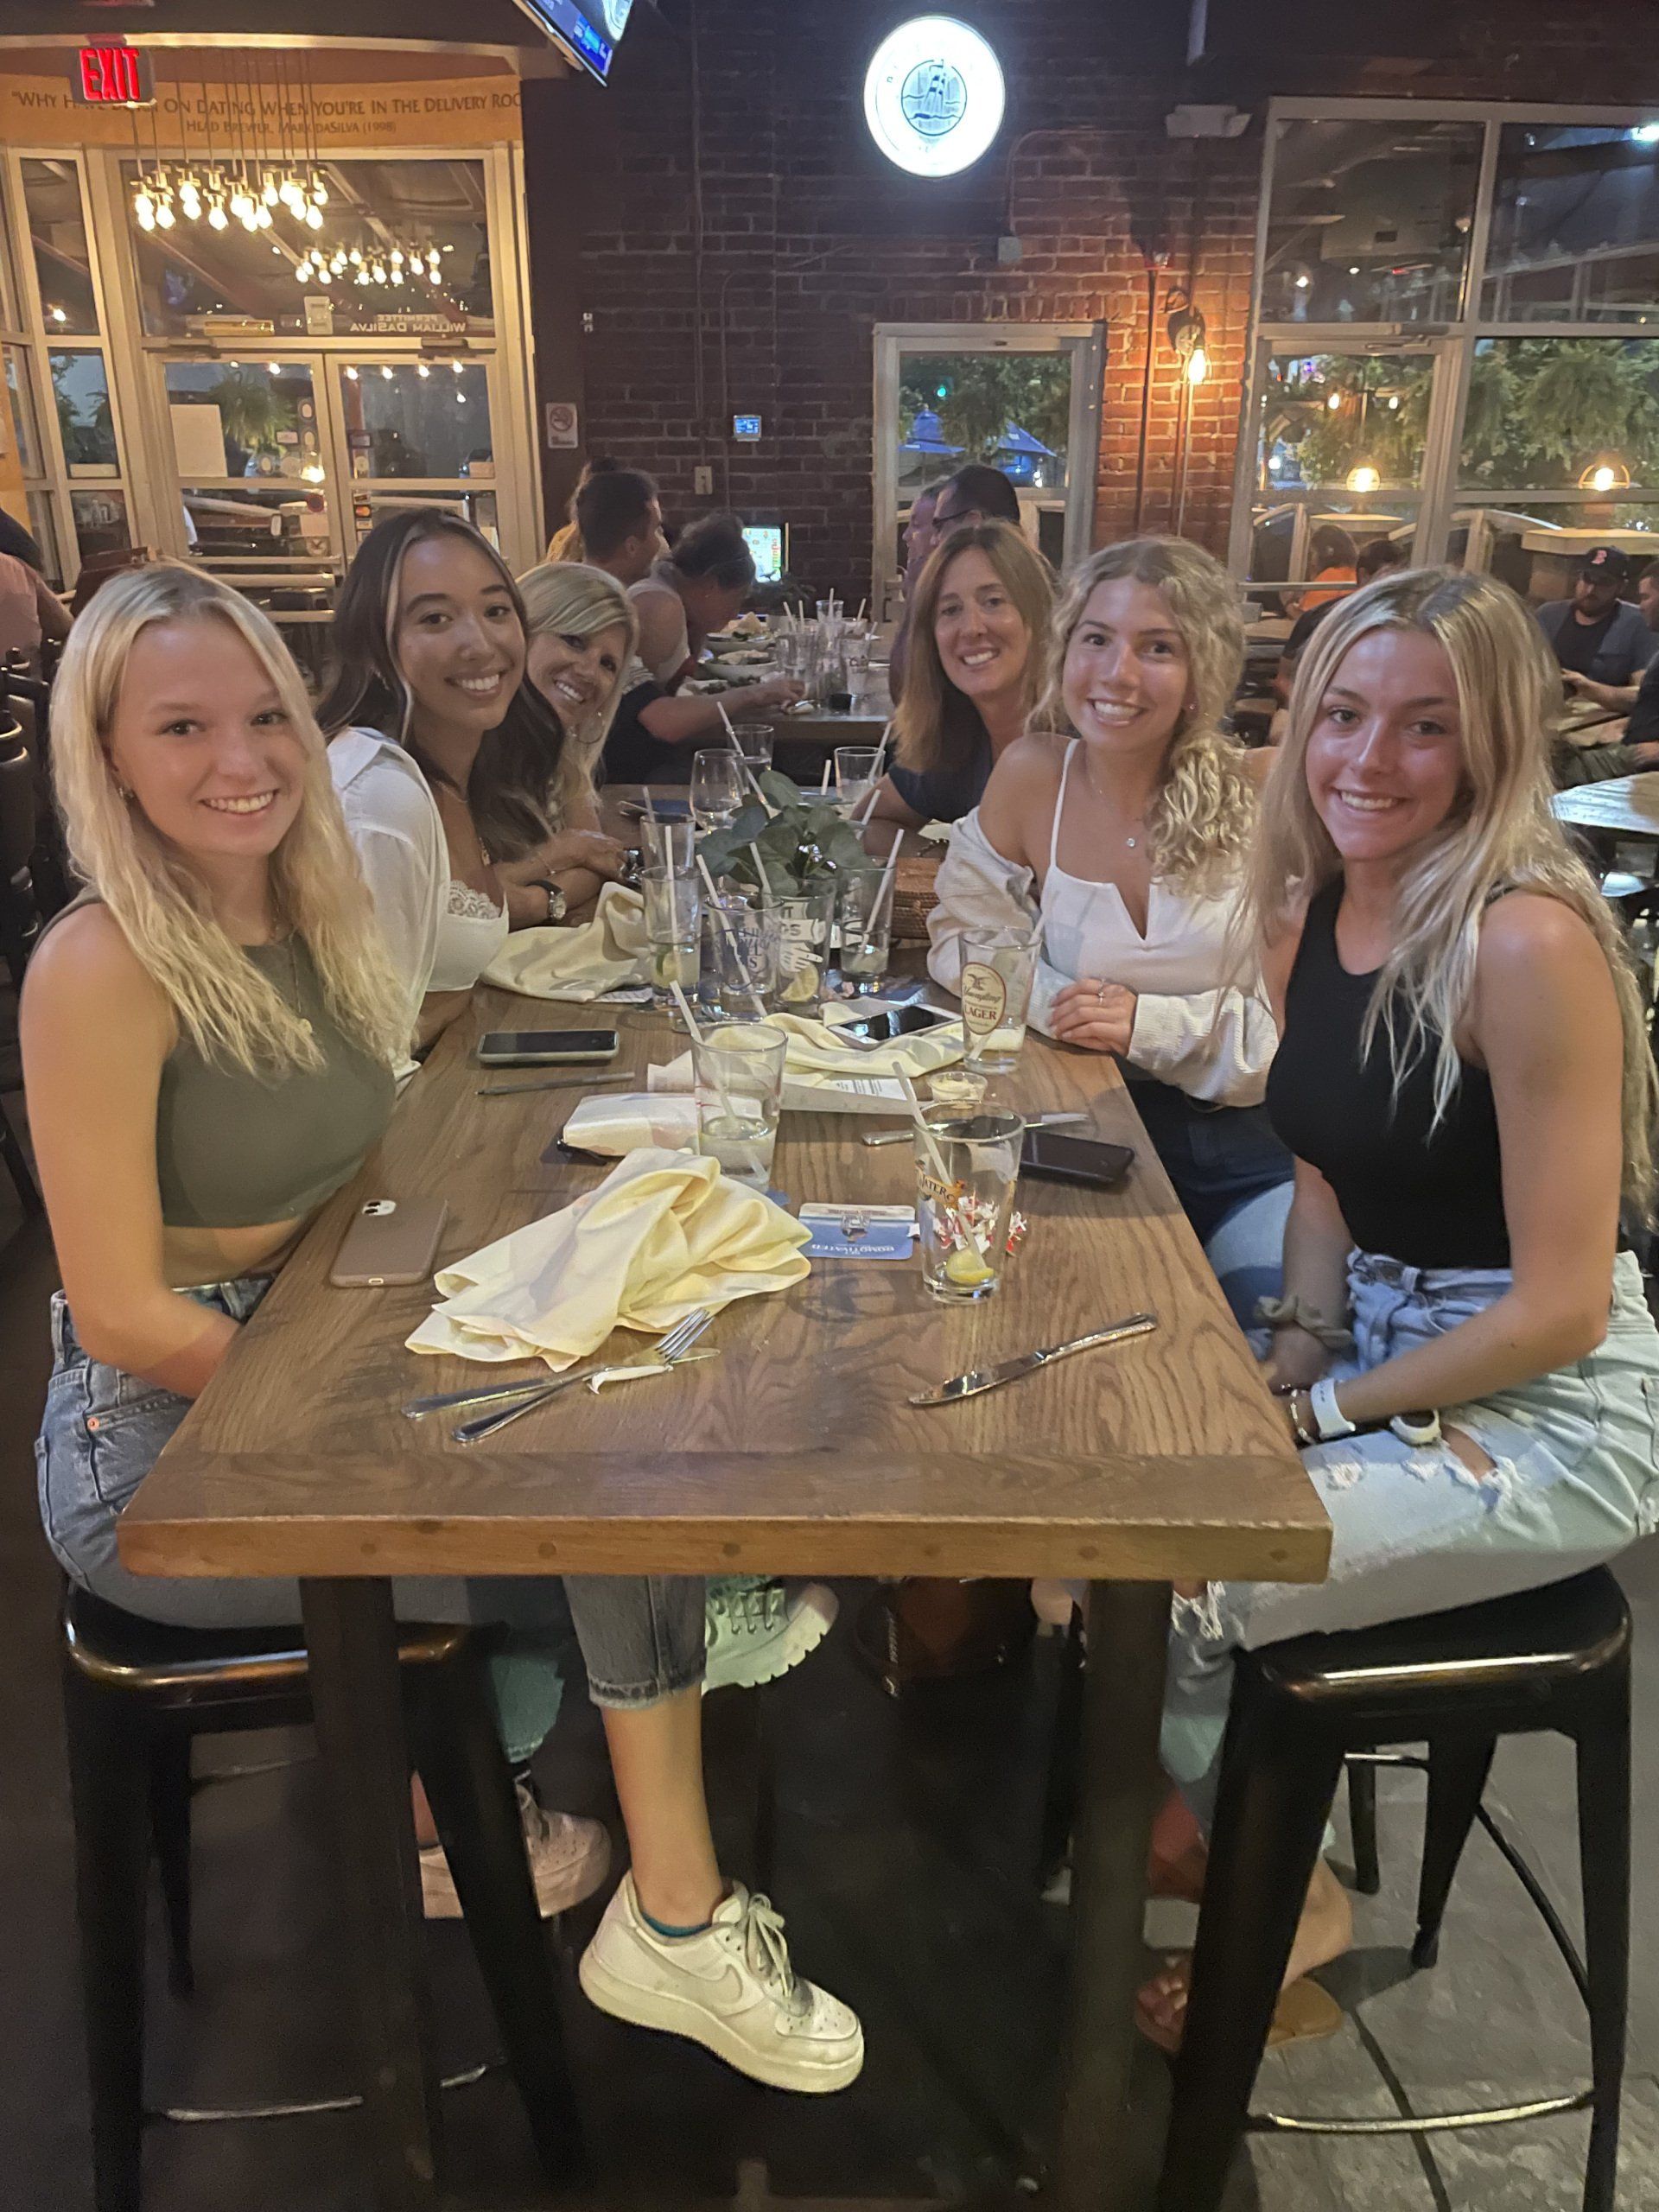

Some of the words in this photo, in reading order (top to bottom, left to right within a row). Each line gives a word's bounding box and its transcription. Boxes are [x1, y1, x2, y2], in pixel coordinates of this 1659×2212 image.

[79, 48, 140, 100] EXIT
[164, 99, 191, 114] ON
[314, 100, 365, 116] YOU'RE
[372, 99, 387, 114] IN
[391, 97, 420, 113] THE
[423, 94, 486, 112] DELIVERY
[965, 1004, 997, 1020] LAGER
